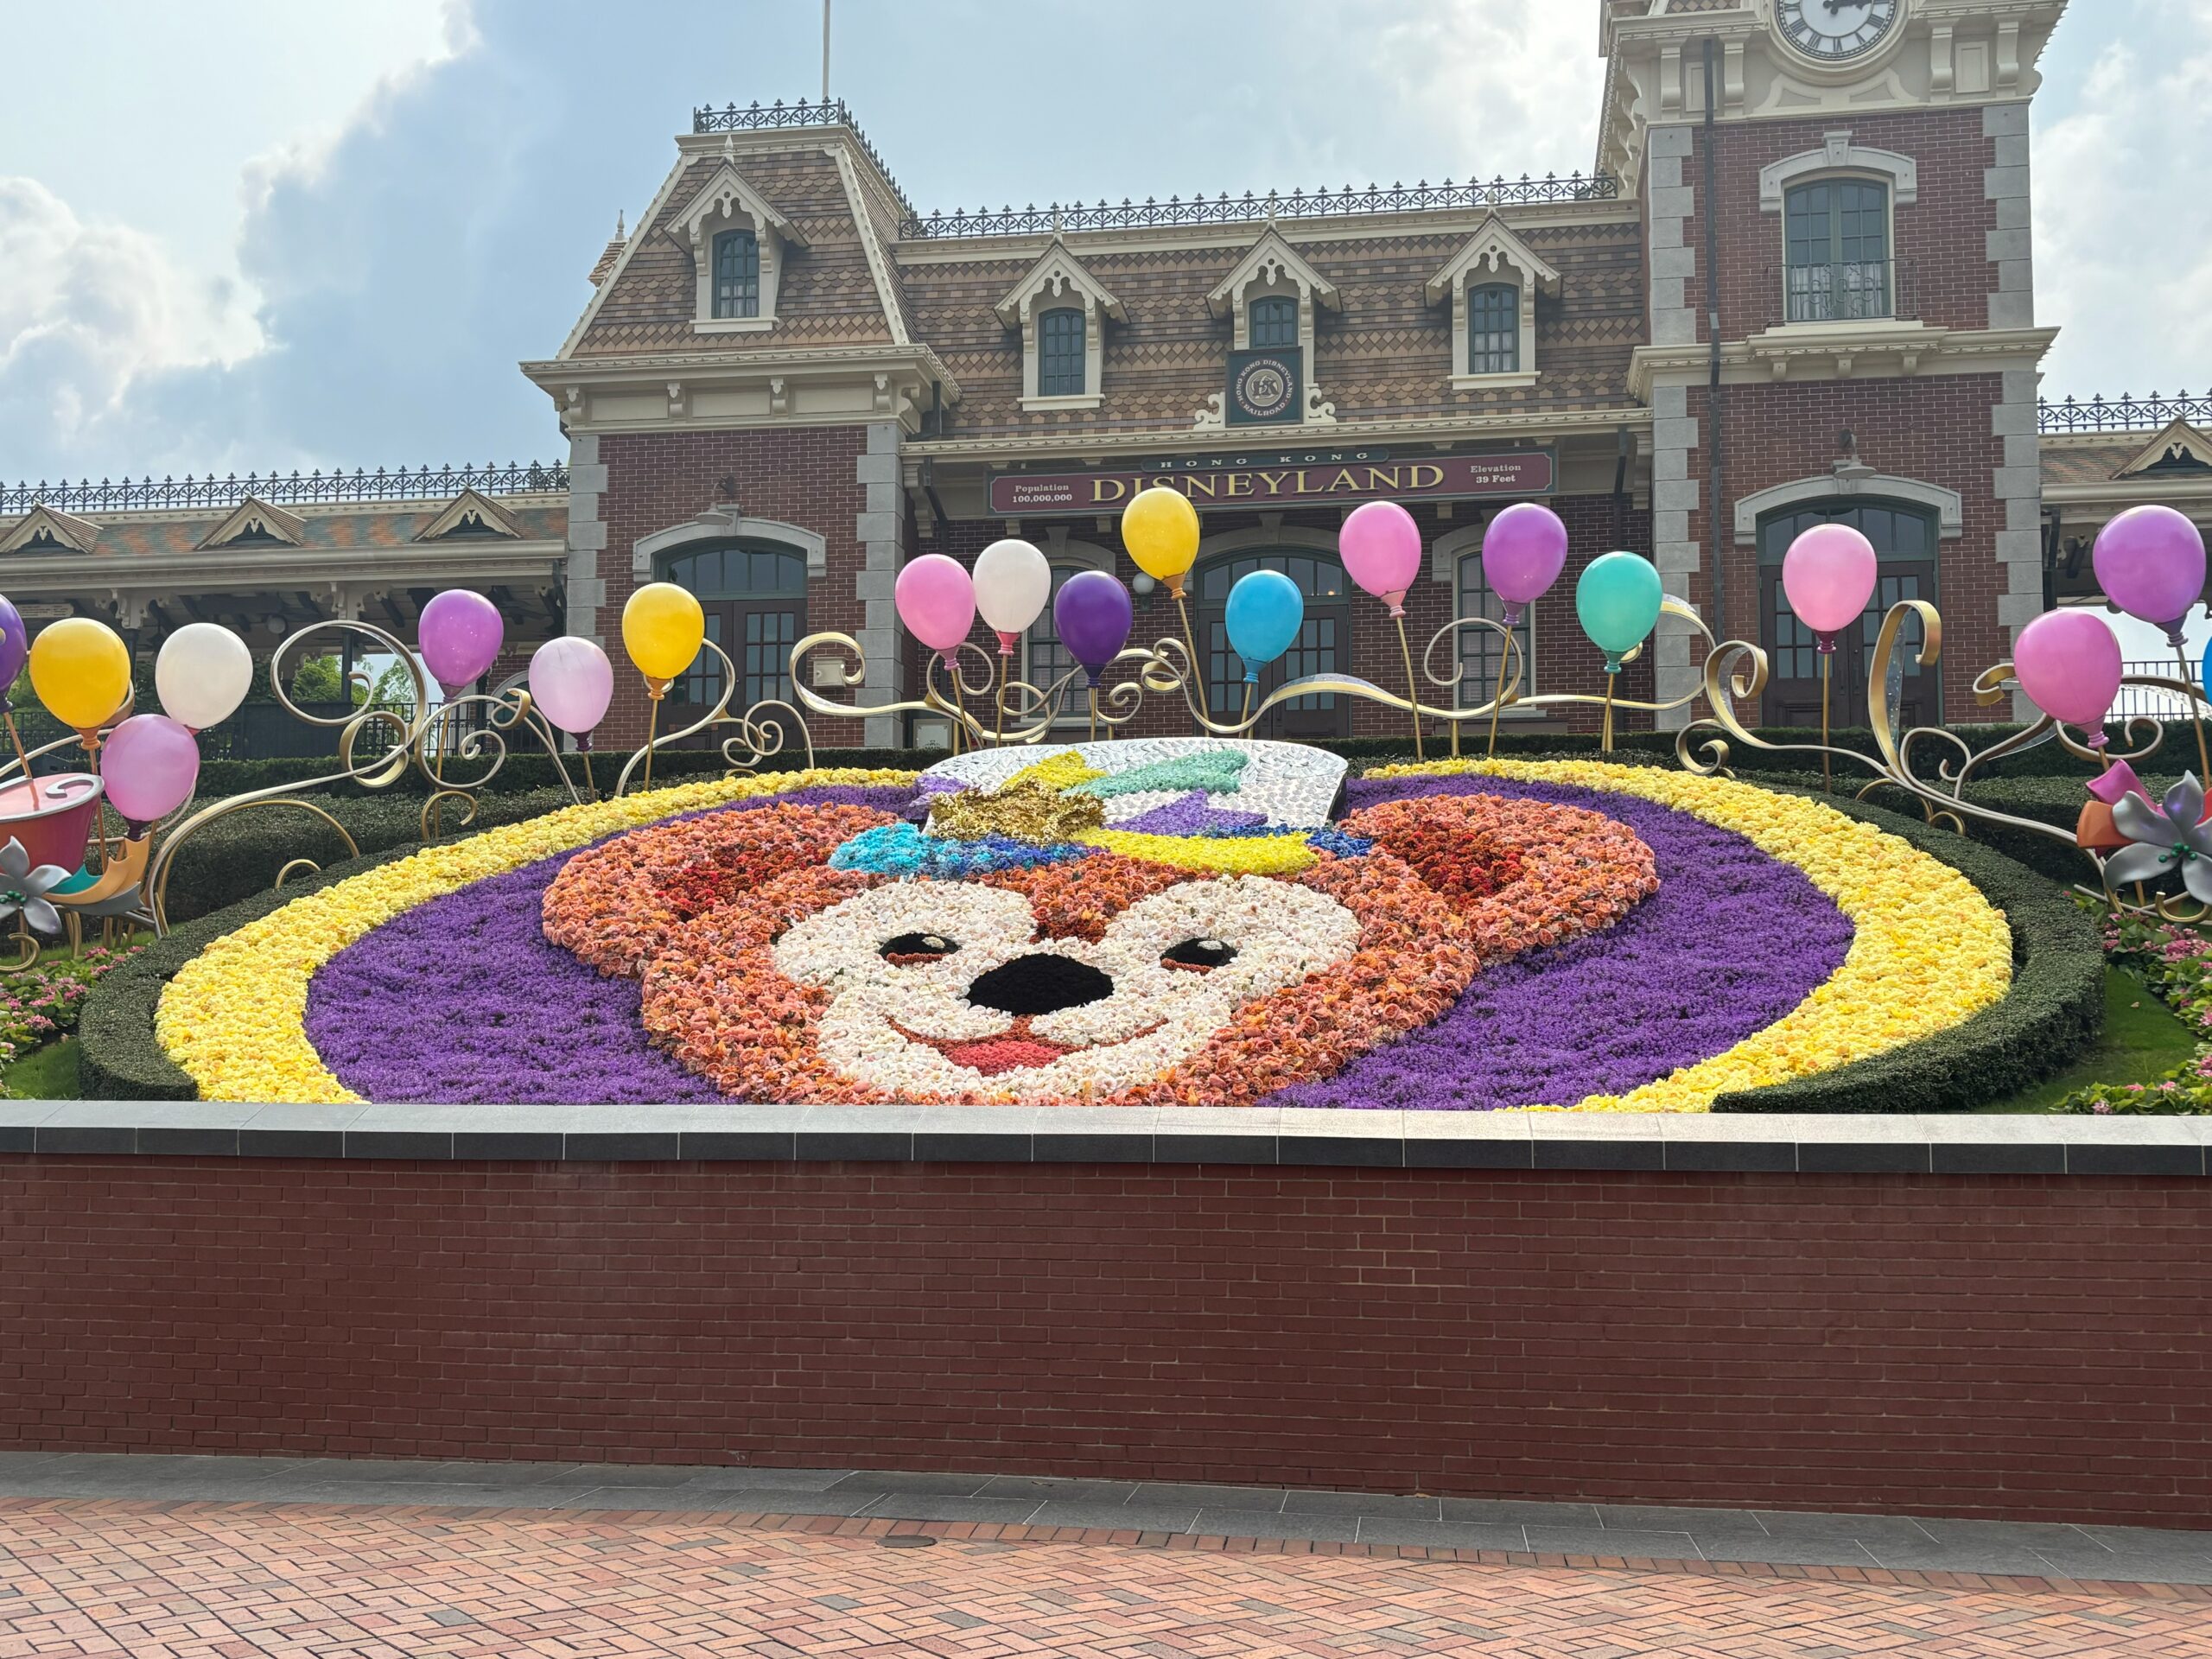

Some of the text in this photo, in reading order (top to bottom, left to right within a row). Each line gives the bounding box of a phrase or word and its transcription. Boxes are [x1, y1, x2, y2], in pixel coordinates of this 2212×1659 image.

[1241, 360, 1261, 377] KONG
[1263, 359, 1293, 398] DISNEYLAND
[1243, 402, 1286, 416] RAILROAD
[1160, 453, 1369, 468] HONG KONG
[1470, 464, 1521, 474] Elevation
[1476, 474, 1516, 484] 39 Feet
[1015, 484, 1069, 493] Population
[1012, 493, 1072, 503] 100,000,000
